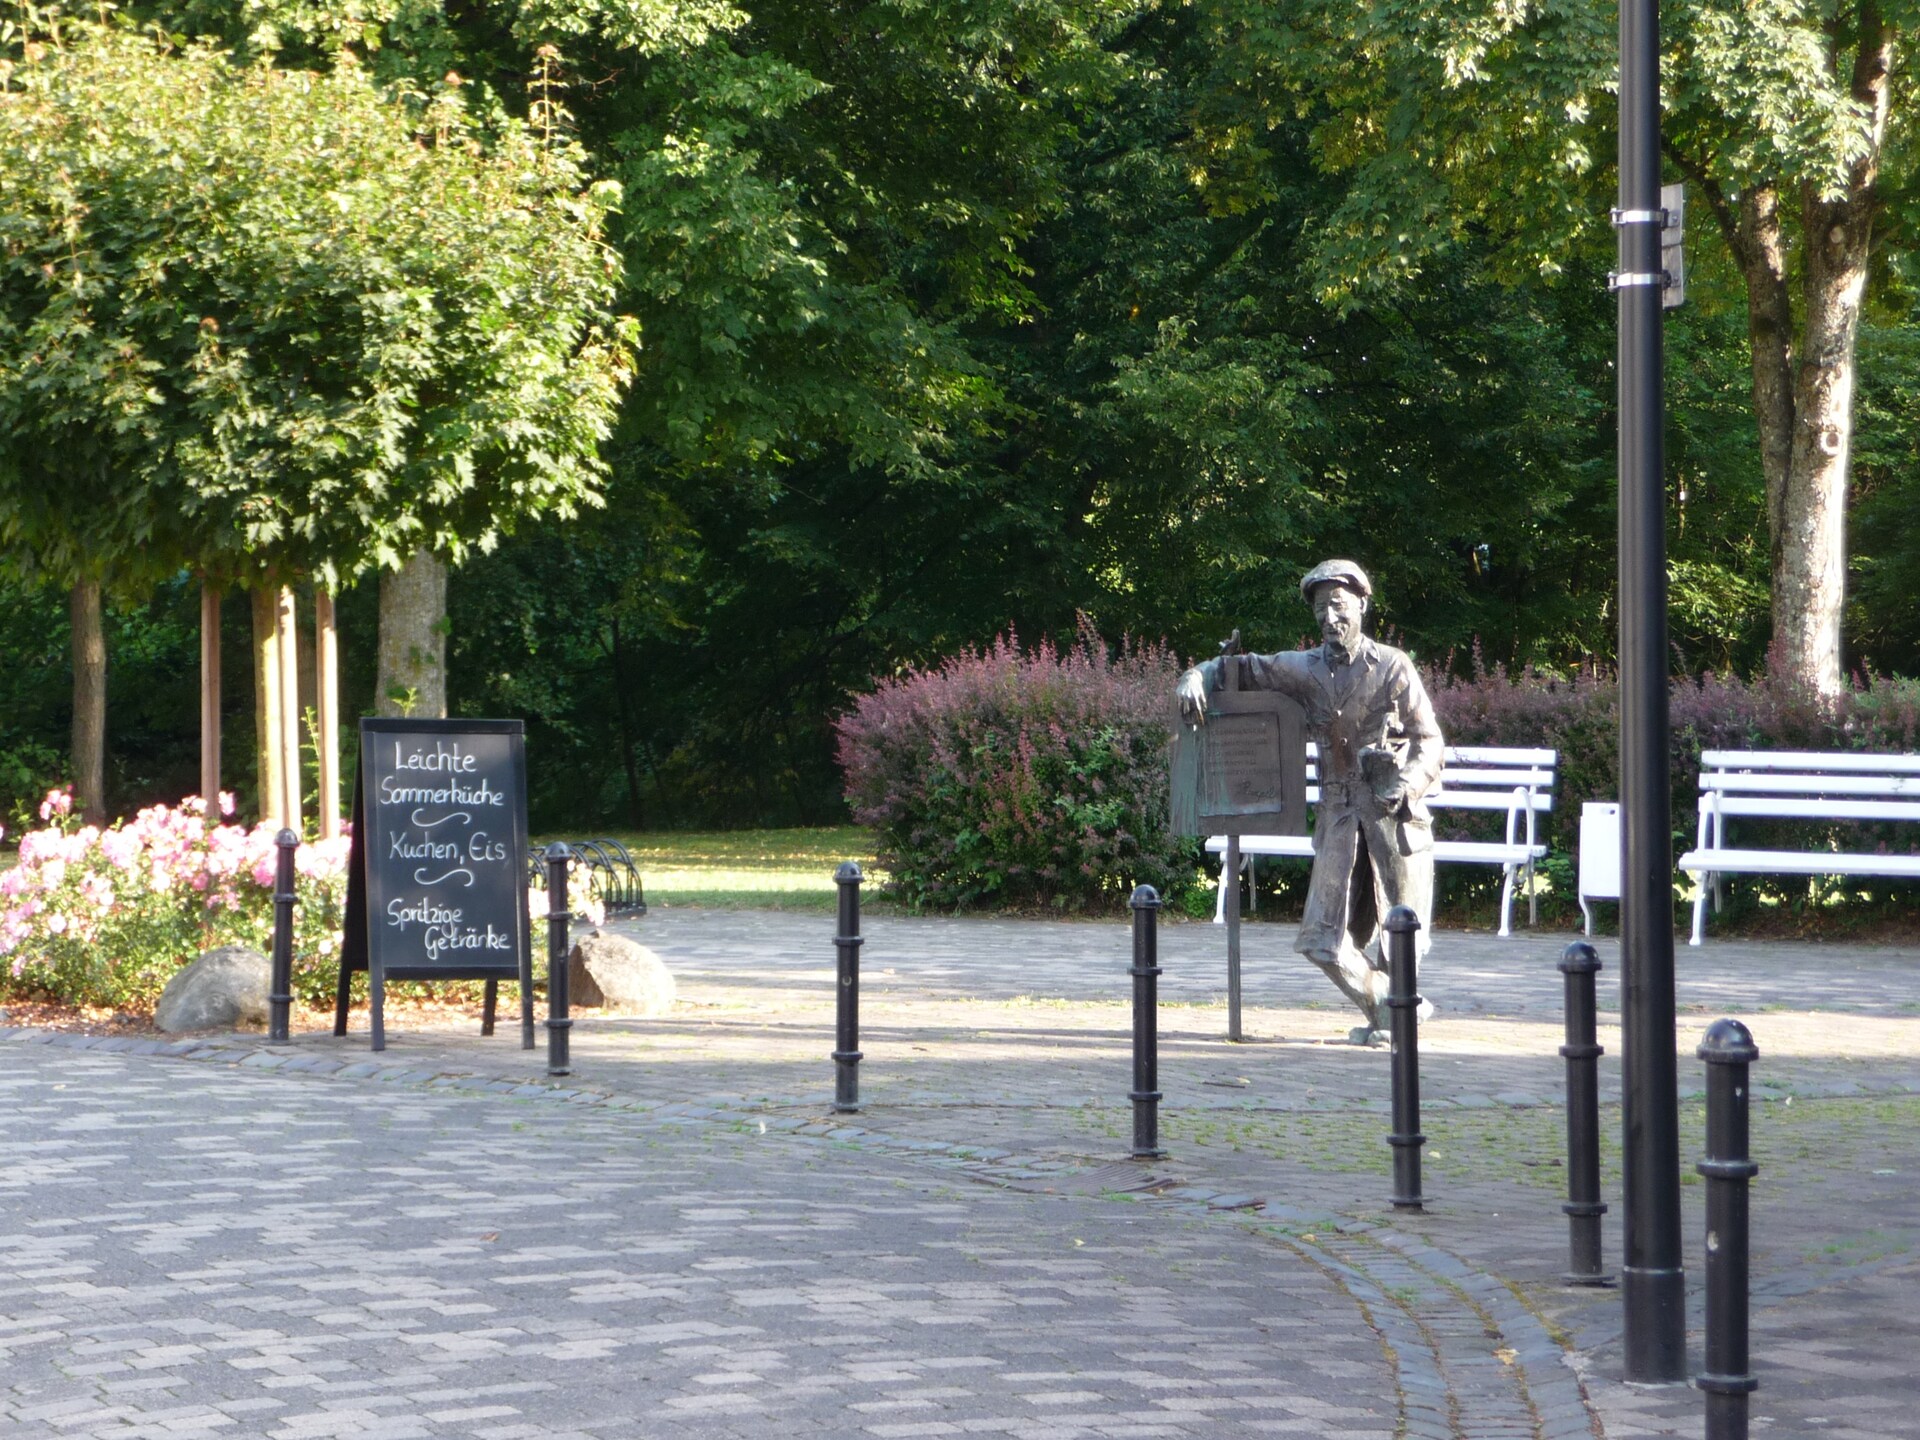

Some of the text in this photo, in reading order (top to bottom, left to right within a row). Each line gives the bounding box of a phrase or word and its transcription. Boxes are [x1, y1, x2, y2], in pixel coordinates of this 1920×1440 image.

[395, 741, 477, 773] Leichte
[380, 775, 504, 806] Sommerküche
[389, 831, 506, 865] Kuchen, Eis
[387, 897, 463, 938] Spritzige
[424, 924, 512, 960] Getränke
